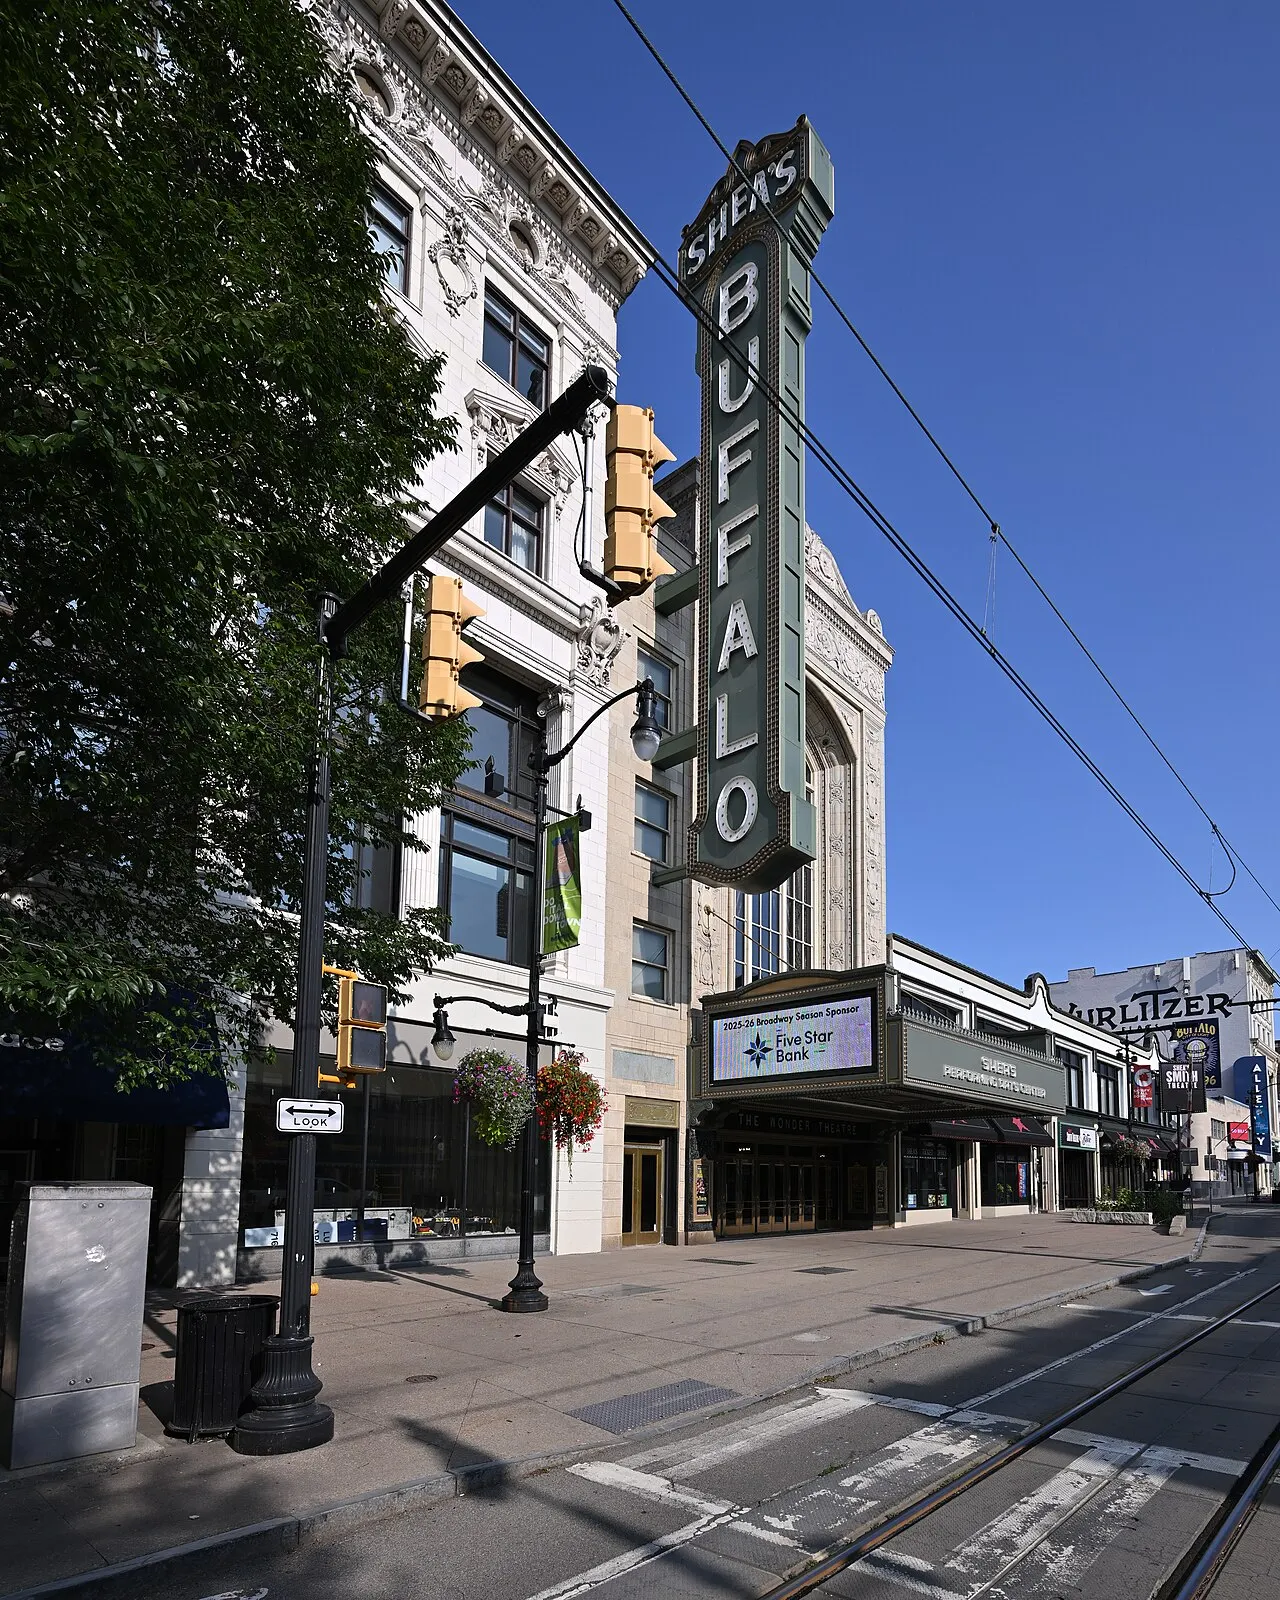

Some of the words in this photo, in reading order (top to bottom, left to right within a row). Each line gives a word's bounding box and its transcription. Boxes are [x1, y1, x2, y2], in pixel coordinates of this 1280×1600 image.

[687, 149, 797, 276] SHEA'S
[715, 261, 760, 843] BUFFALO
[723, 1018, 755, 1031] 2025-26
[756, 1014, 794, 1027] Broadway
[795, 1010, 824, 1021] Season
[826, 1005, 860, 1019] Sponsor
[776, 1033, 802, 1048] Five
[804, 1030, 834, 1045] Star
[1176, 1022, 1216, 1039] BUFFALO
[776, 1046, 810, 1063] Bank
[943, 1064, 998, 1088] PERFORMING
[998, 1078, 1020, 1093] ARTS
[1020, 1082, 1046, 1099] CENTER
[1166, 1070, 1199, 1083] SMITH
[1253, 1063, 1266, 1146] ALLEY
[293, 1117, 328, 1127] LOOK
[738, 1113, 760, 1127] THE
[770, 1116, 810, 1131] WONDER
[818, 1121, 857, 1136] THEATRE
